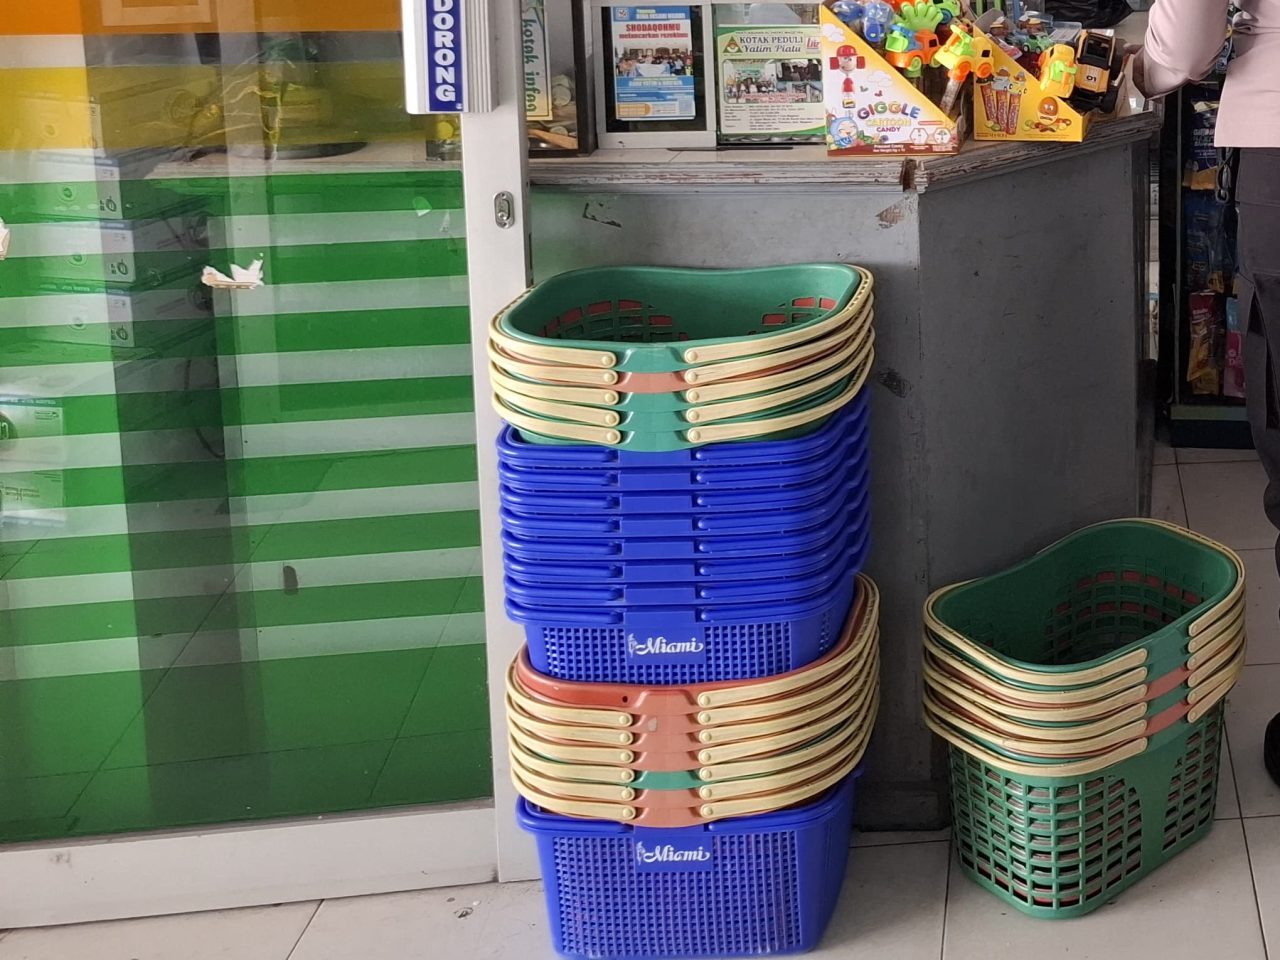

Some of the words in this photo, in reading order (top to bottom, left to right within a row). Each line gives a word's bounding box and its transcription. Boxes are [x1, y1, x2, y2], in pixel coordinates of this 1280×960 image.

[625, 23, 681, 32] SHODAQOHMU
[739, 36, 770, 44] KOTAK
[771, 36, 803, 44] PEDULI
[743, 44, 772, 53] Yatim
[775, 44, 802, 53] Piatu
[857, 100, 921, 120] GIGGLE
[634, 634, 704, 656] Miami
[642, 844, 711, 864] Miami
